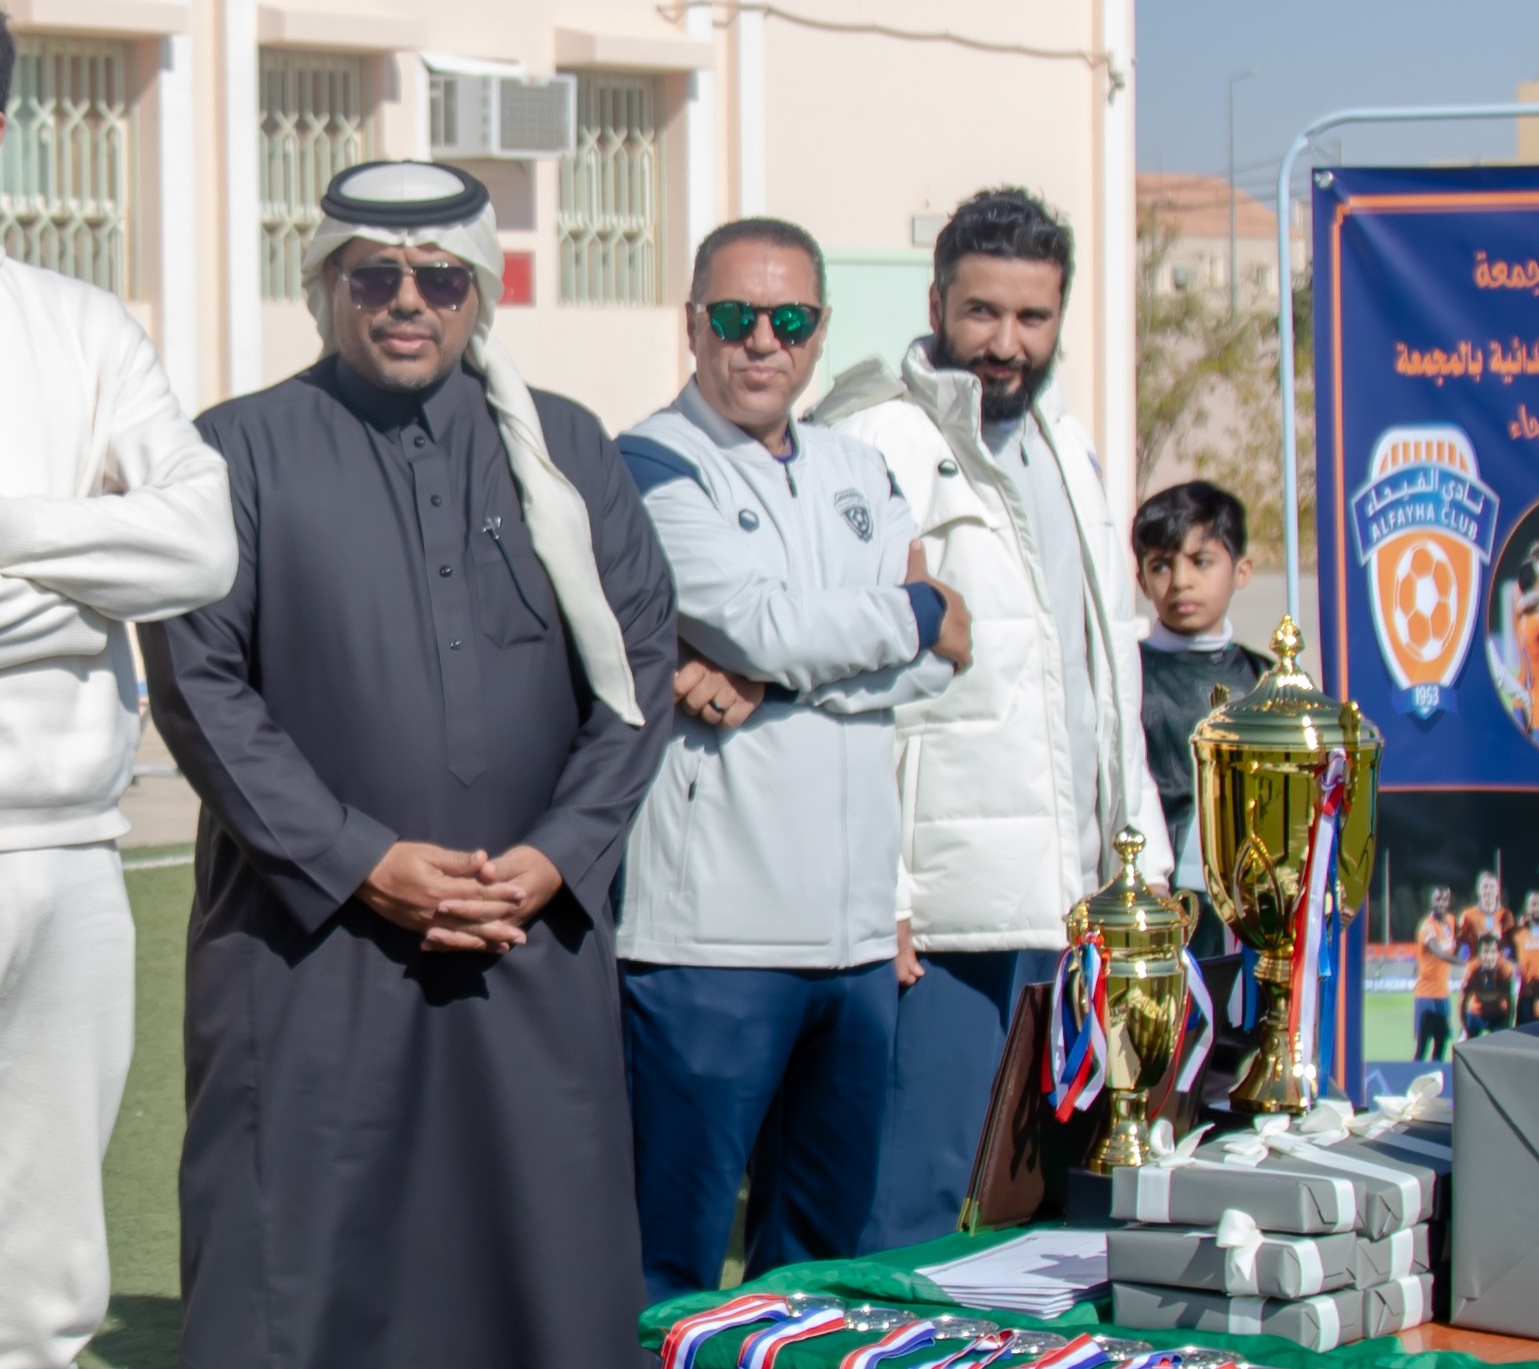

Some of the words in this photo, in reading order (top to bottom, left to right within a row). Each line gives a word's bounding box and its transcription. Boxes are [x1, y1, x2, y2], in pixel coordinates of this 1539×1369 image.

[1395, 339, 1483, 387] بالمجمعة
[1367, 468, 1441, 518] الفيحاء
[1441, 479, 1485, 515] نادي
[1371, 501, 1436, 544] ALFAYHA
[1441, 505, 1479, 542] CLUB
[1415, 685, 1440, 707] 1953
